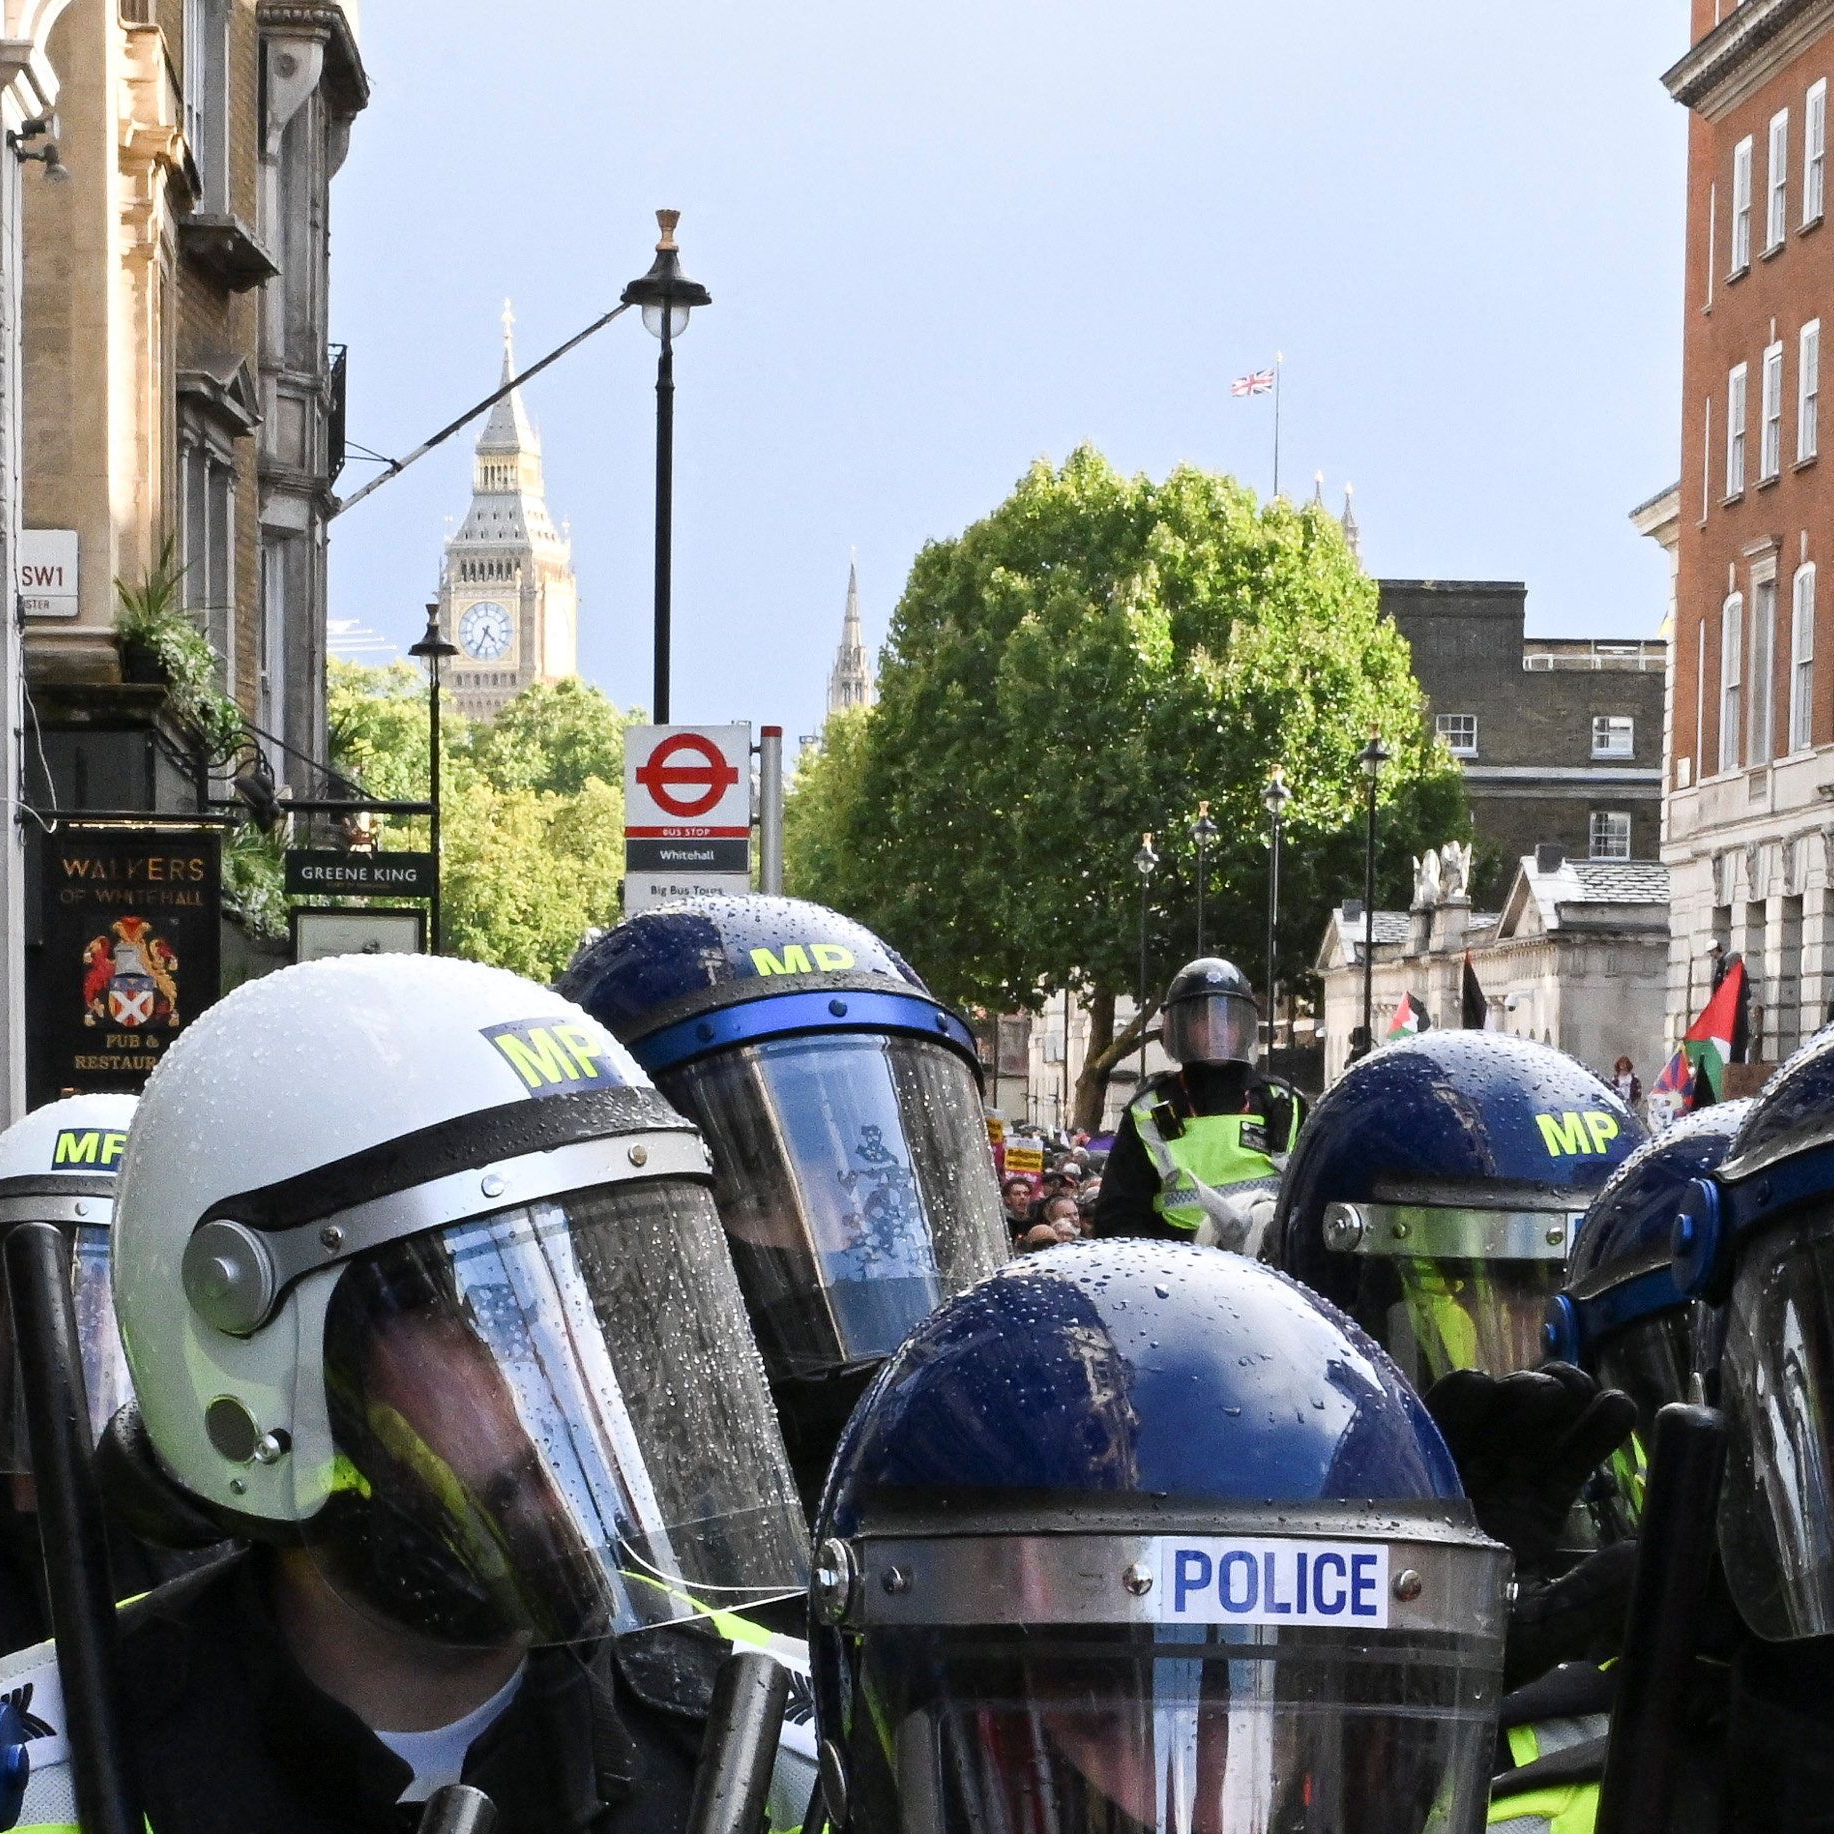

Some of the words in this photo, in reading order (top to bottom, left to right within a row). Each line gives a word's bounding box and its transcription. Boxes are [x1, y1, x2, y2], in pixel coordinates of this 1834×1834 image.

[22, 566, 63, 586] SW1
[24, 600, 50, 609] STER
[662, 828, 681, 836] BUS
[685, 828, 711, 836] STOP
[660, 850, 714, 860] Whitehall
[62, 858, 204, 881] WALKERS
[301, 866, 367, 880] GREENE
[374, 868, 417, 882] KING
[60, 889, 86, 904] OF
[651, 885, 666, 897] Big
[670, 885, 689, 895] Bus
[106, 1034, 140, 1049] PUB
[146, 1035, 159, 1048] &
[74, 1055, 158, 1071] RESTAUR
[494, 1025, 604, 1088] MP
[1535, 1111, 1620, 1157] MP
[1173, 1548, 1378, 1617] POLICE
